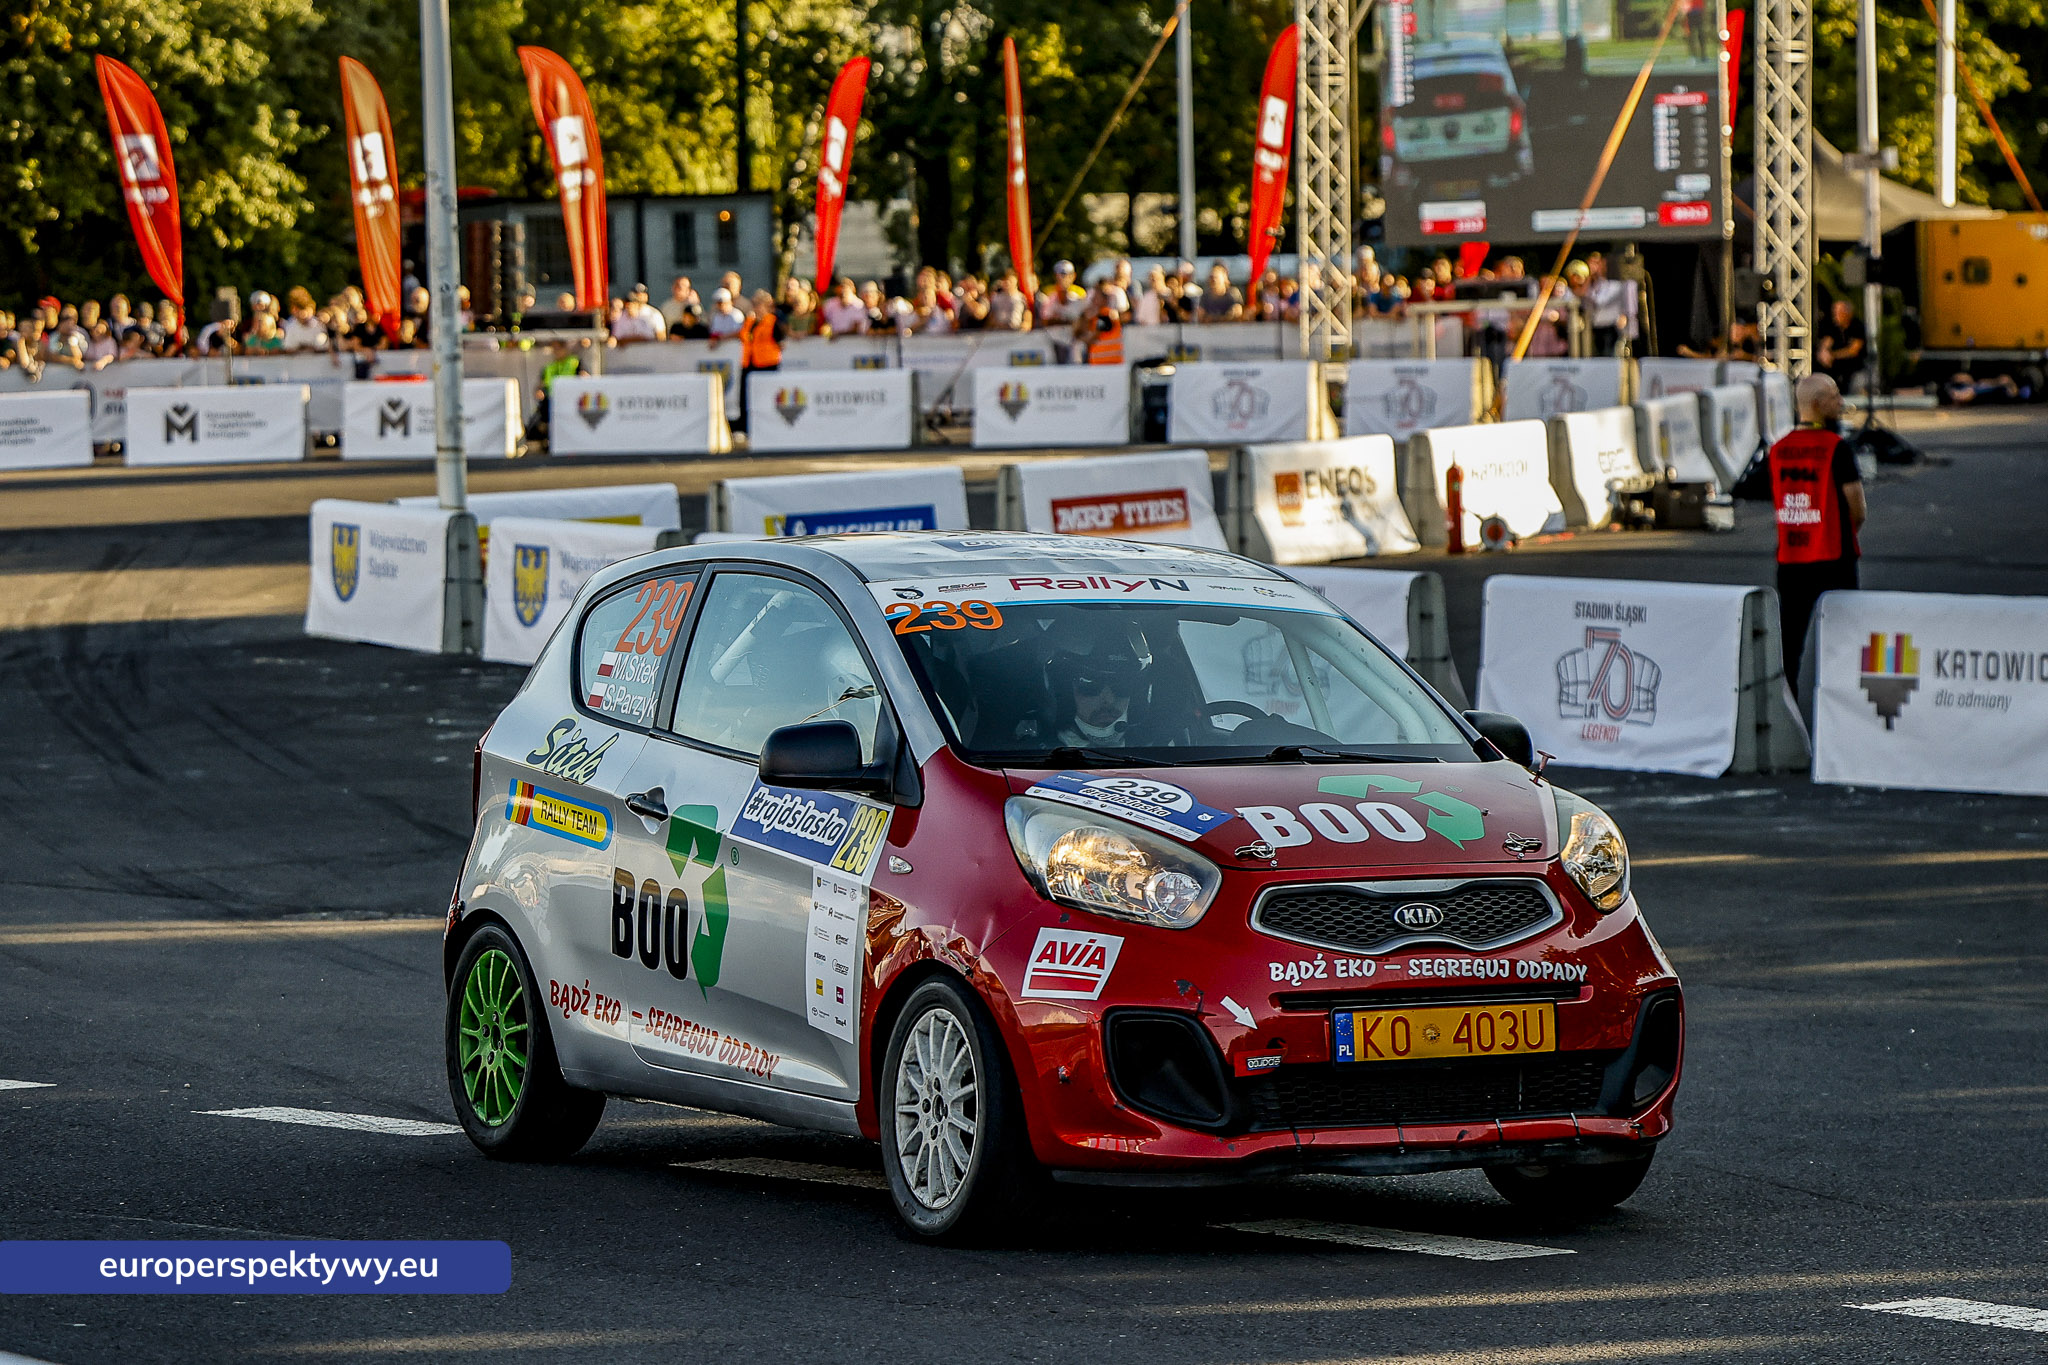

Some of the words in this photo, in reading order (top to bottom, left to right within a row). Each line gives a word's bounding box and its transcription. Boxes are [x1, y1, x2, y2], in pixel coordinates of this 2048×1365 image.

[1304, 466, 1377, 498] ENEOS
[1057, 504, 1120, 531] MRF
[1123, 498, 1185, 526] TYRES
[615, 579, 694, 657] 239
[885, 600, 1004, 636] 239
[1575, 601, 1614, 620] STADION
[1615, 602, 1648, 627] ŚLĄSKI
[611, 653, 660, 685] M.Sitek
[1586, 626, 1635, 721] 70
[1935, 650, 2048, 682] KATOWIC
[602, 684, 659, 723] S.Parzyk
[1584, 703, 1600, 719] LAT
[1957, 691, 2013, 713] odmiany
[1581, 723, 1622, 743] LEGENDY
[1104, 780, 1182, 805] 239
[540, 799, 571, 826] RALLY
[570, 810, 598, 835] TEAM
[747, 790, 846, 843] #rajdslaska
[1234, 801, 1428, 849] BOO
[831, 805, 888, 874] 239
[612, 866, 689, 981] BOO
[1403, 908, 1437, 924] KIA
[1268, 953, 1328, 986] BĄDŹ
[1334, 958, 1377, 977] EKO
[1408, 958, 1511, 980] SEGREGUJ
[1516, 960, 1589, 983] ODPADY
[549, 979, 591, 1019] BĄDŹ
[593, 993, 622, 1026] EKO
[645, 1006, 719, 1056] SEGREGUJ
[719, 1034, 780, 1080] ODPADY
[1453, 1008, 1545, 1053] 403U
[1339, 1044, 1352, 1056] PL
